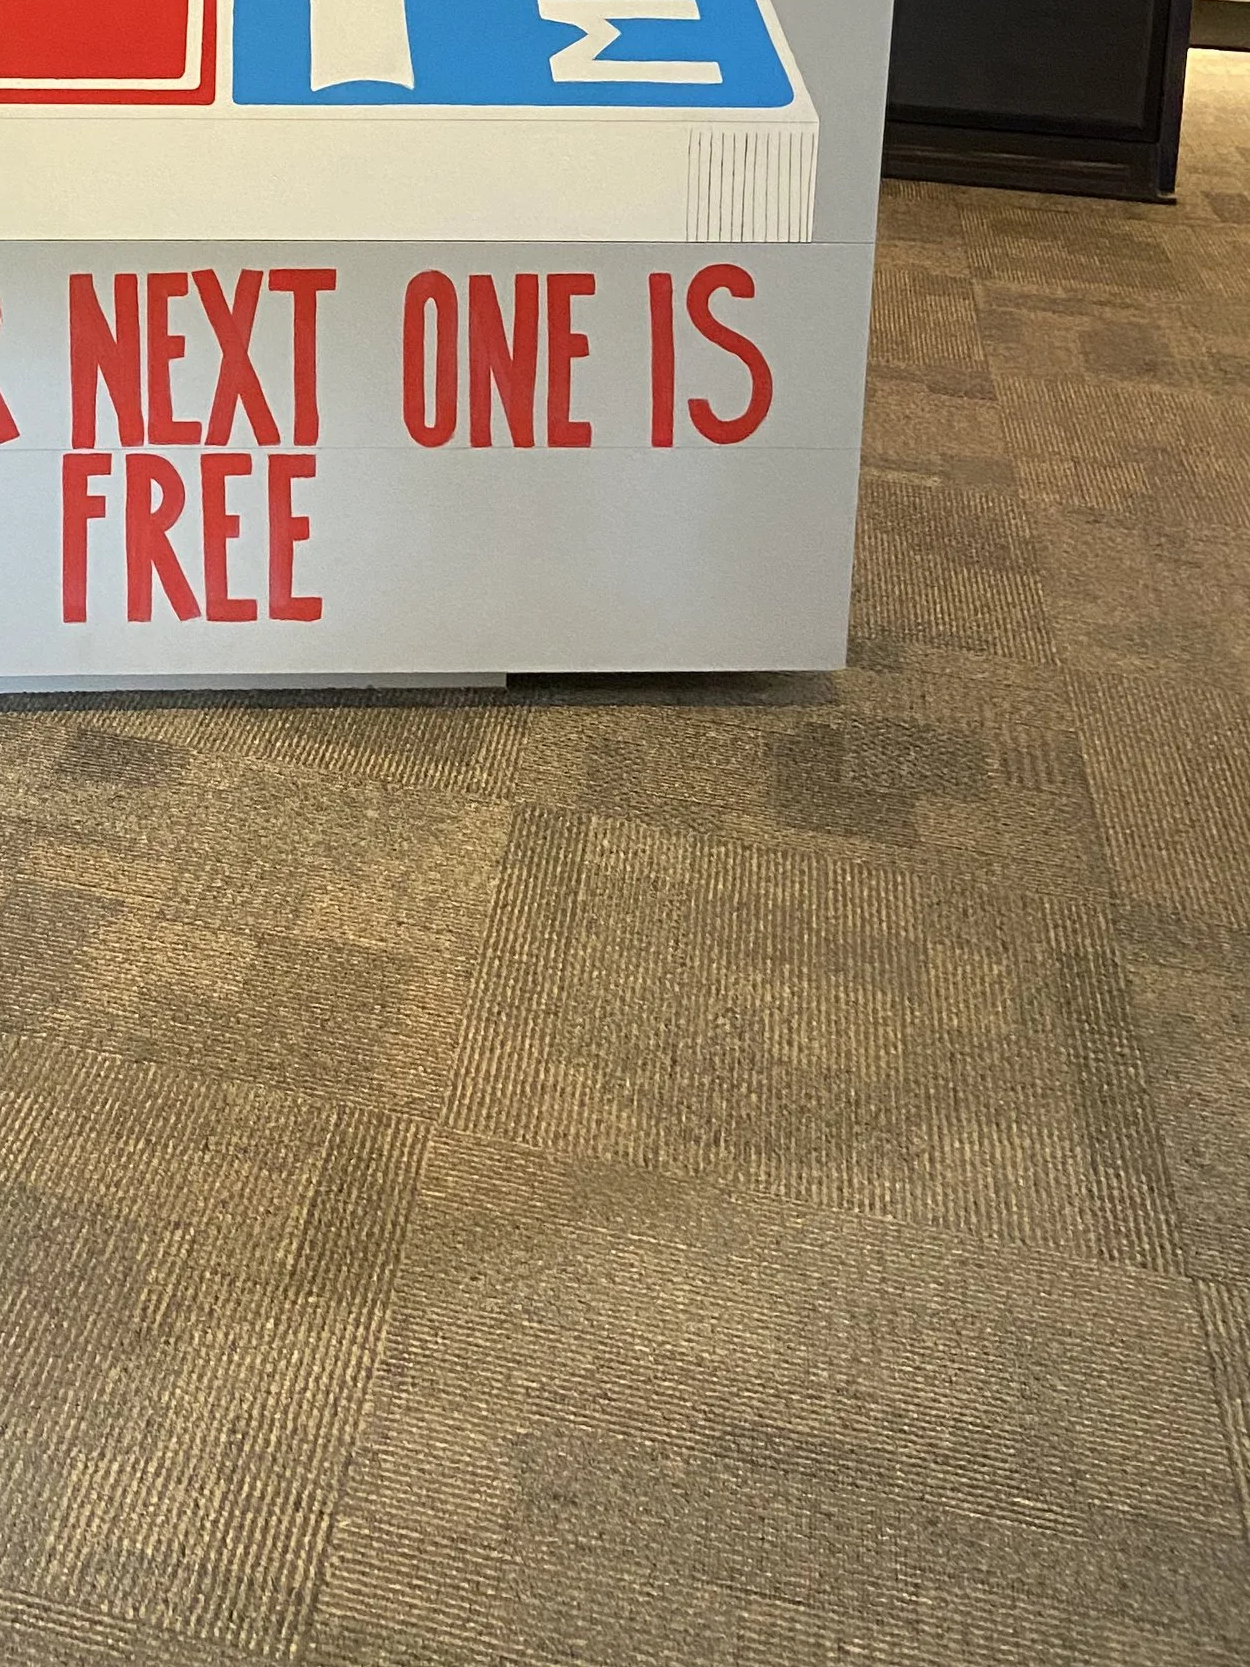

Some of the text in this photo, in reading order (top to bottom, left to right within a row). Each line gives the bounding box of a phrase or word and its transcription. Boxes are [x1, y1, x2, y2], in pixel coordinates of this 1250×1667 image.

[68, 268, 337, 450] NEXT
[402, 269, 597, 448] ONE
[648, 263, 773, 448] IS
[62, 452, 323, 624] FREE
